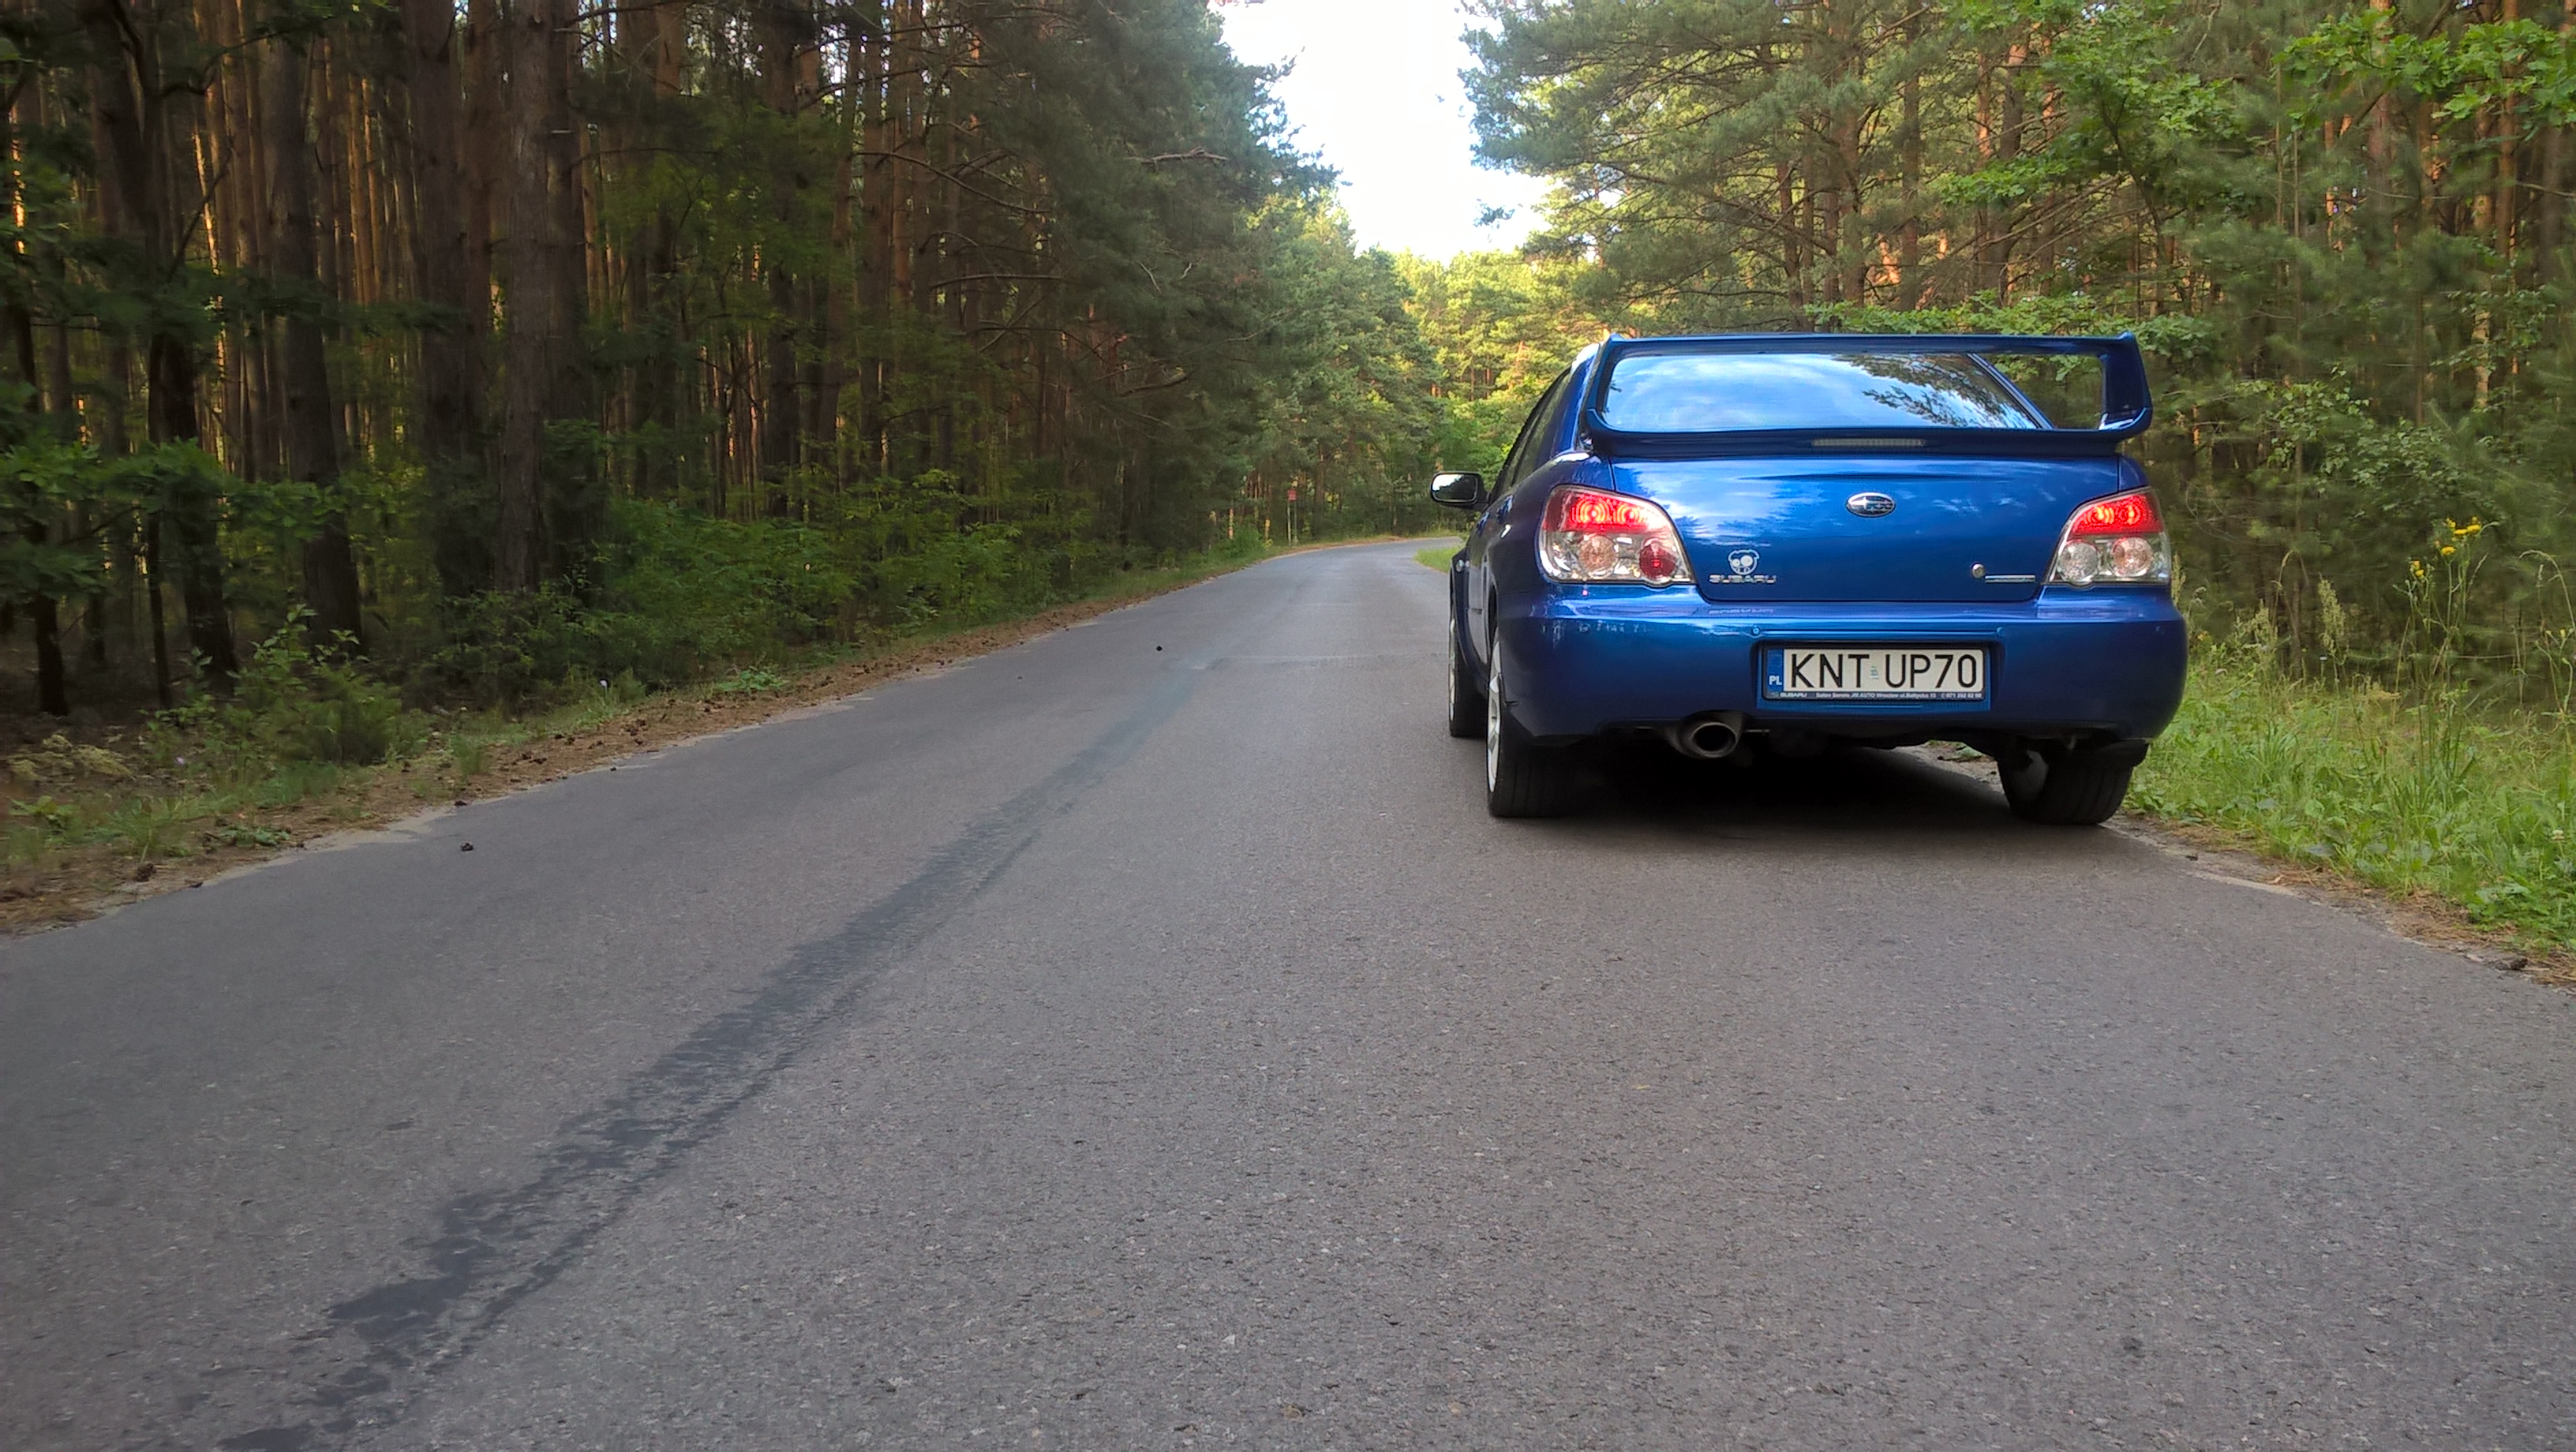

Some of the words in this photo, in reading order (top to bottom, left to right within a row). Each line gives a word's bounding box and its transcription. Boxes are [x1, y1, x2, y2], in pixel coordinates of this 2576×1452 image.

[1709, 574, 1777, 584] SUBARU
[1792, 653, 1870, 688] KNT
[1885, 653, 1978, 688] UP70
[1768, 675, 1783, 686] PL
